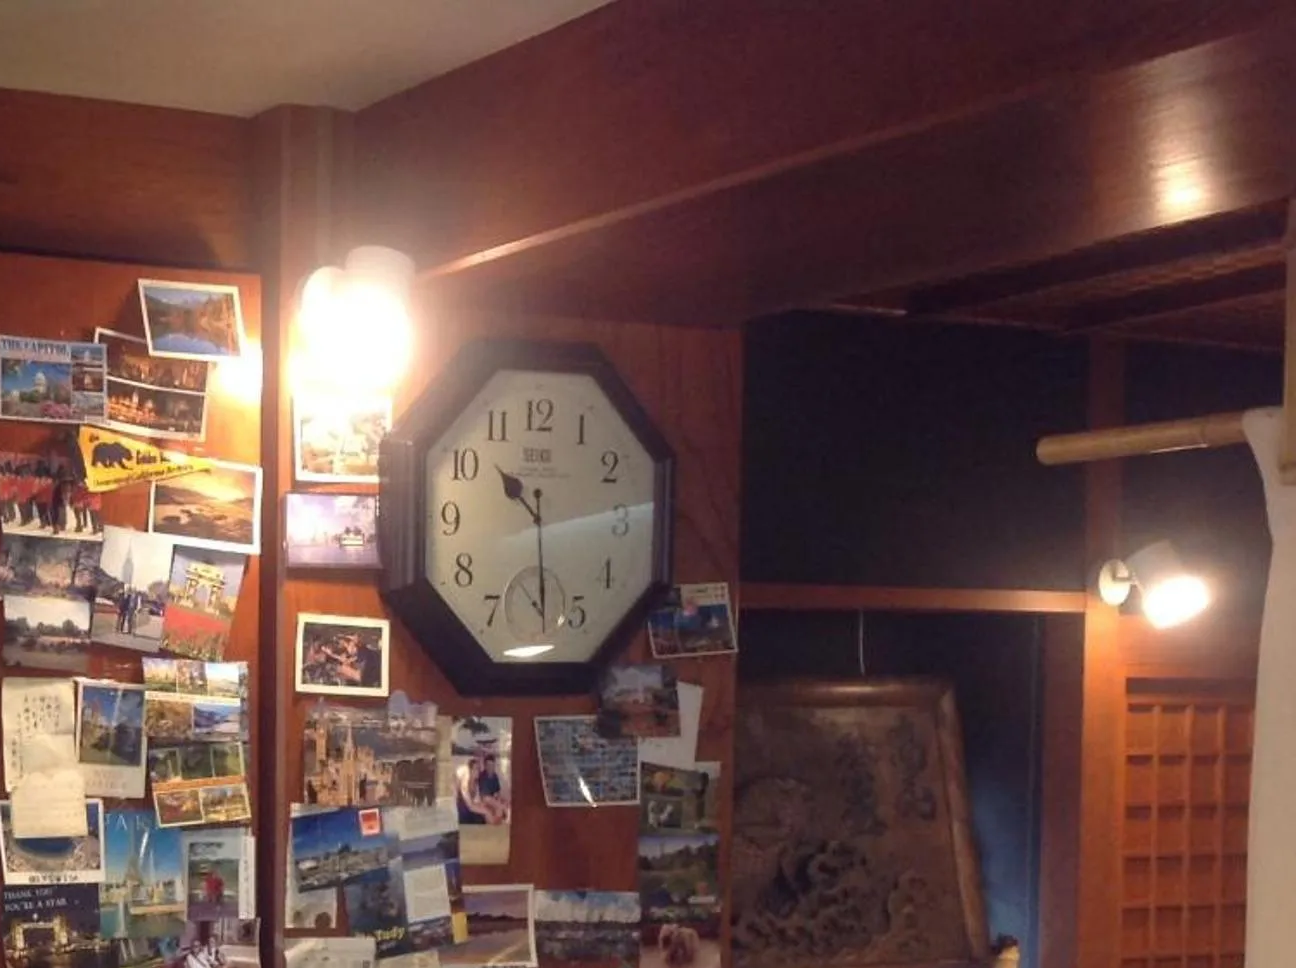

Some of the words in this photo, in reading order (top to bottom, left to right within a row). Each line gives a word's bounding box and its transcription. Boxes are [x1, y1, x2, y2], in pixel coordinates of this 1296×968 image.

[487, 410, 509, 442] 11
[525, 399, 554, 431] 12
[576, 414, 586, 445] 1
[451, 448, 479, 481] 10
[601, 451, 619, 483] 2
[441, 501, 461, 536] 9
[611, 503, 629, 537] 3
[454, 553, 474, 587] 8
[596, 557, 615, 589] 4
[484, 595, 501, 627] 7
[568, 596, 586, 628] 5
